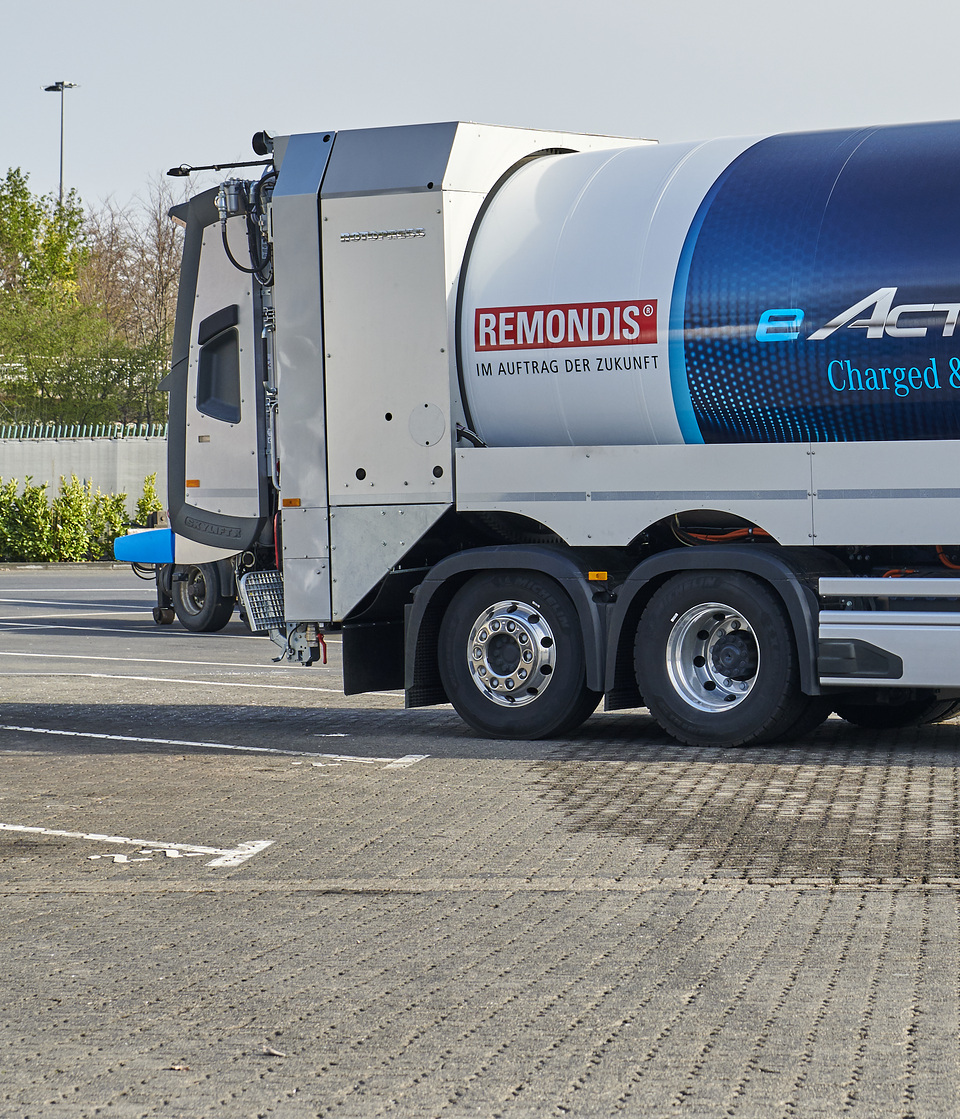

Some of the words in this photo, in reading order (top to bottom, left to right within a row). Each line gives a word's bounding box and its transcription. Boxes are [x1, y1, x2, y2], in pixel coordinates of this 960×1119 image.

[476, 363, 493, 377] IM
[498, 359, 559, 376] AUFTRAG
[565, 358, 591, 373] DER
[596, 355, 659, 372] ZUKUNFT
[827, 357, 943, 397] Charged
